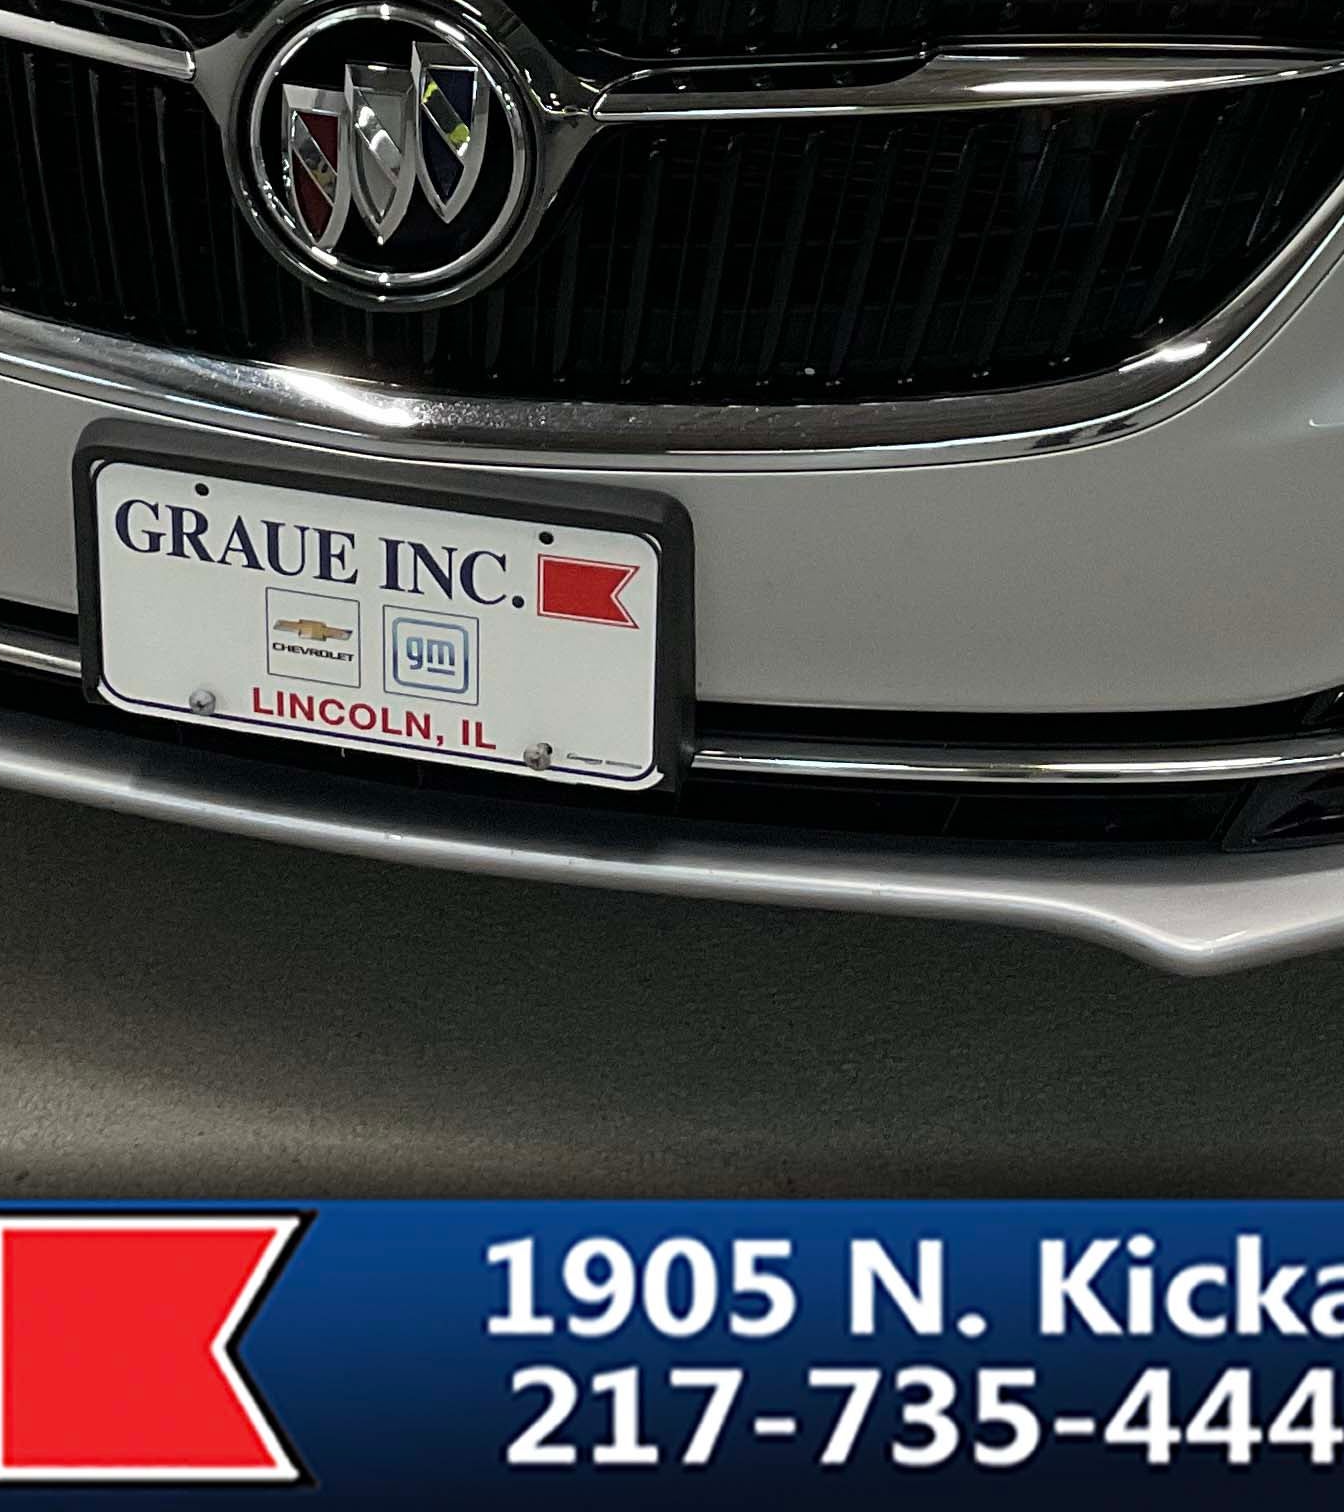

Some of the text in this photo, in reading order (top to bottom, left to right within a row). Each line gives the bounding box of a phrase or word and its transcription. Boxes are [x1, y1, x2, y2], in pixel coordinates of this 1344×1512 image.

[114, 498, 525, 610] GRAUE INC.
[272, 641, 355, 663] CHEVROLET
[406, 636, 455, 676] gm
[252, 686, 497, 751] LINCOLN, IL
